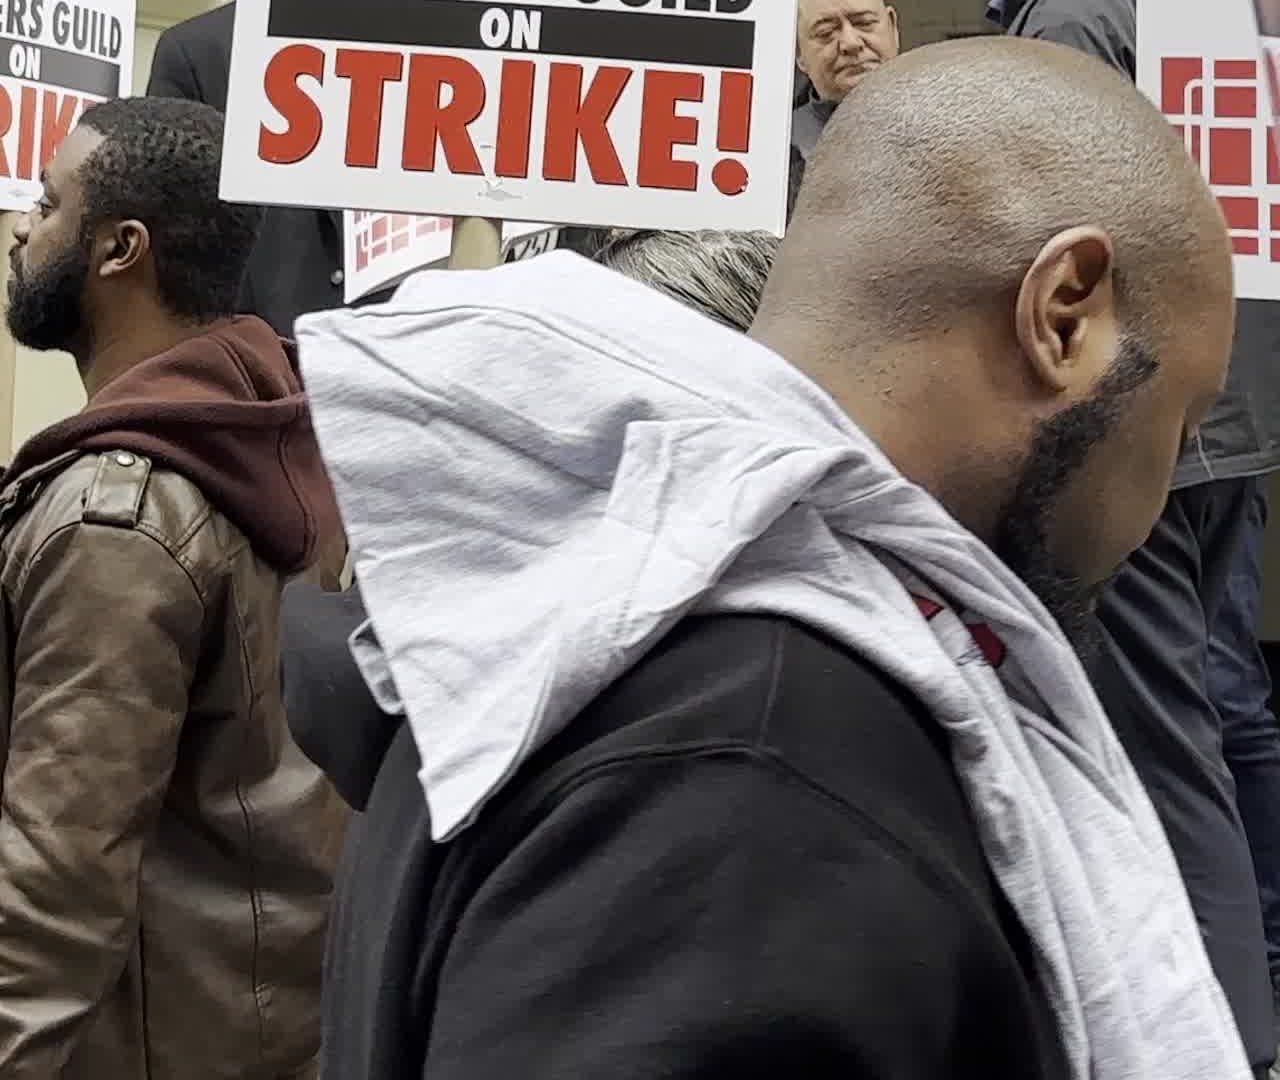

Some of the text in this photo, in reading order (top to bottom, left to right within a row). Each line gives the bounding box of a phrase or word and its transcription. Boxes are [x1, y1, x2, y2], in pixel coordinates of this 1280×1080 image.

[52, 0, 122, 59] GUILD
[479, 6, 543, 51] ON
[8, 43, 41, 82] ON
[257, 42, 755, 196] STRIKE!
